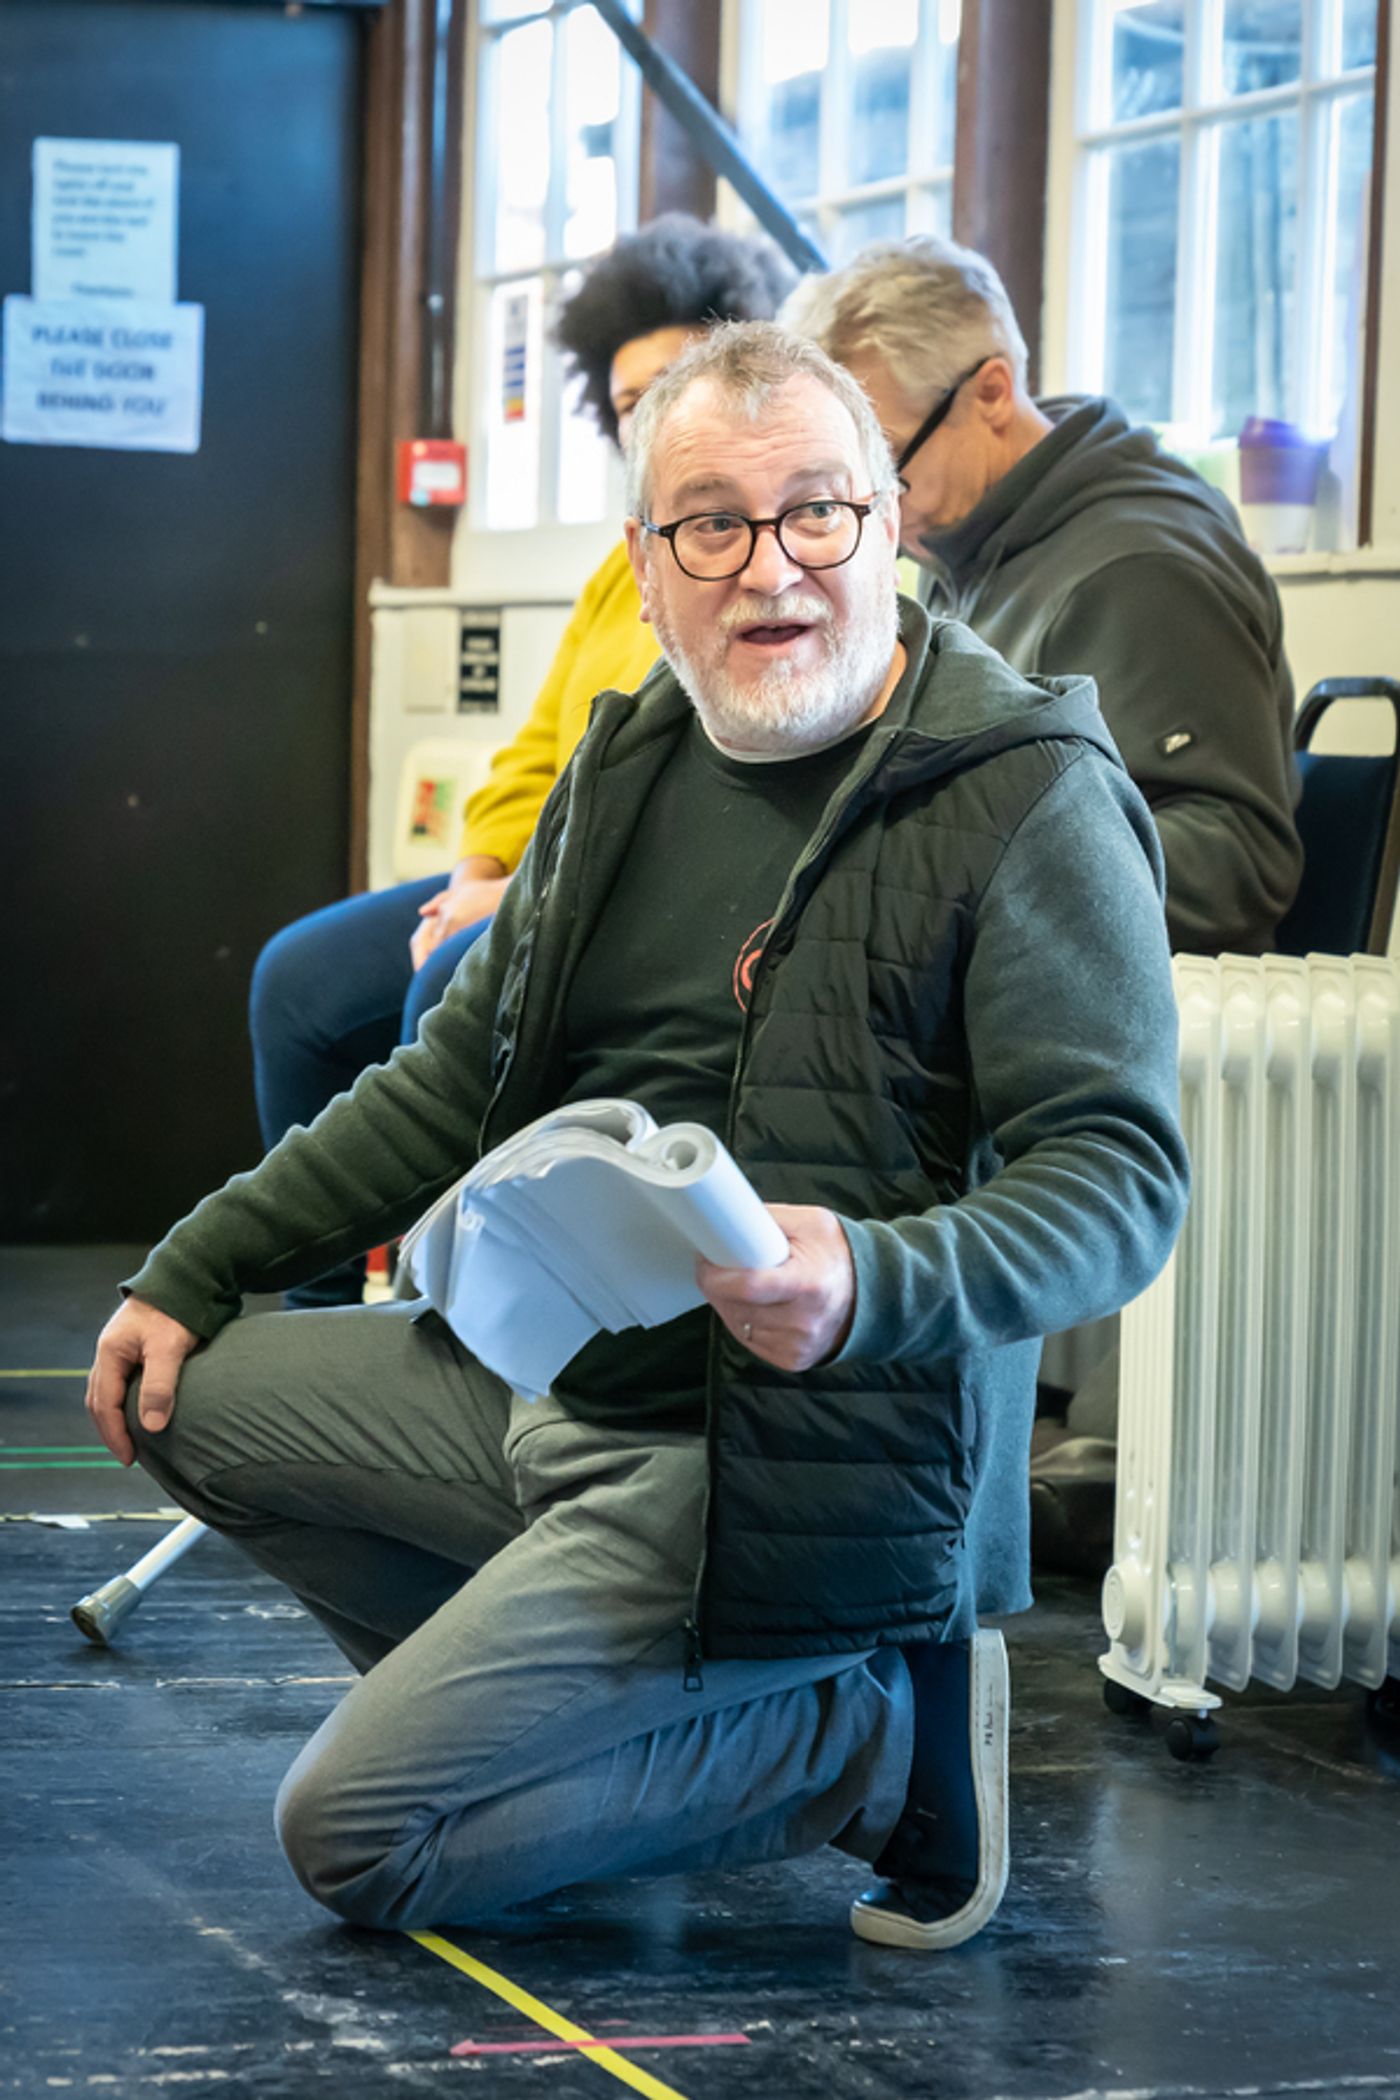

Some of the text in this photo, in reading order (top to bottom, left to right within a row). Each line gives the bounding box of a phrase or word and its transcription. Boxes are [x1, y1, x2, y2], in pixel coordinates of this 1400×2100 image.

[32, 328, 102, 347] PLEASE
[38, 393, 165, 416] BEHIND YOU
